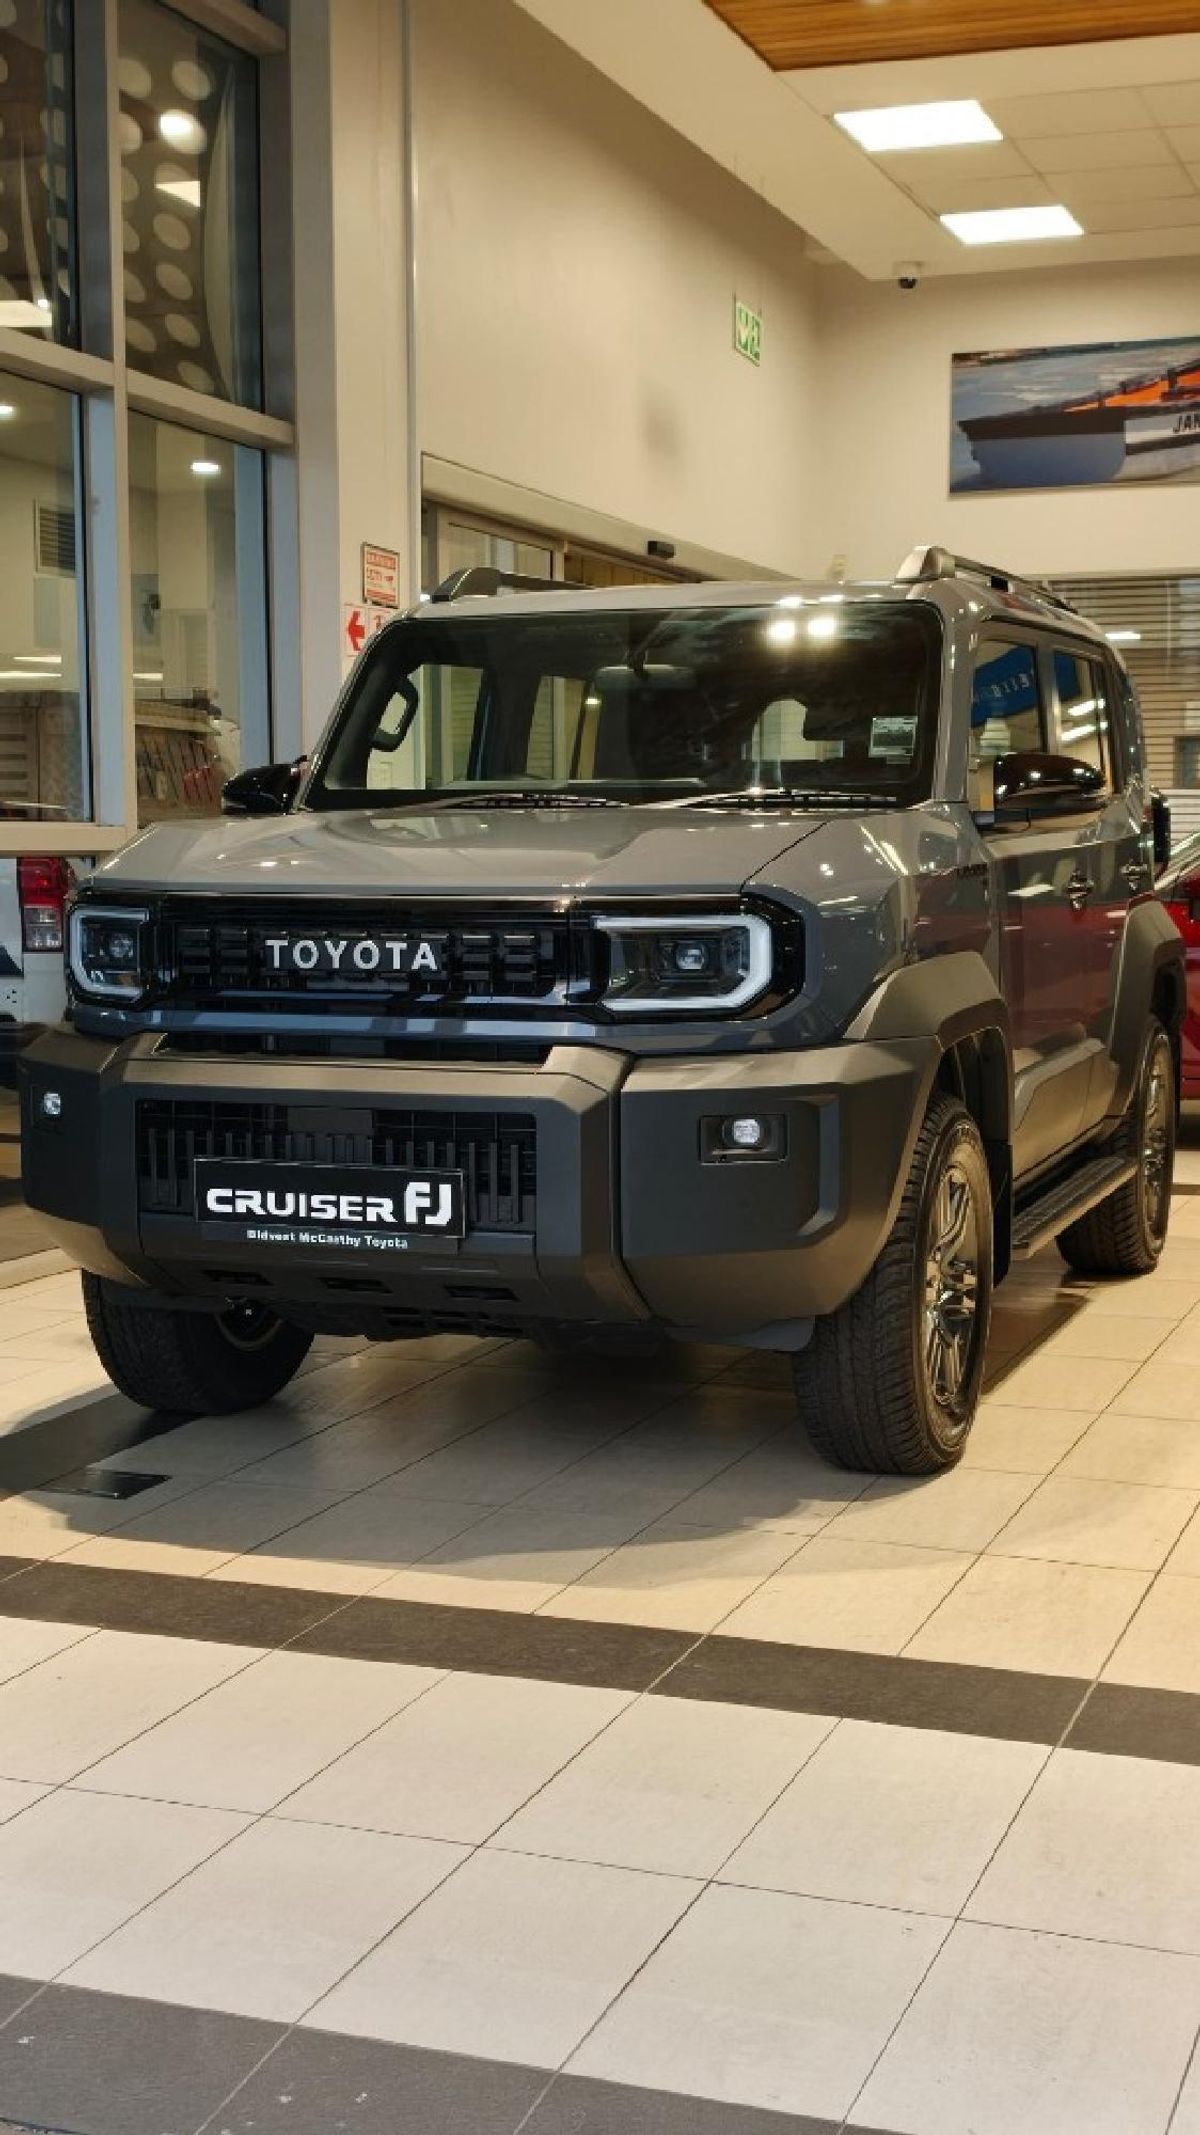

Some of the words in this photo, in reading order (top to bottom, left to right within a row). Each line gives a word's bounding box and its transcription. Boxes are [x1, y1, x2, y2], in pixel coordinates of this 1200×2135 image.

[265, 939, 438, 971] TOYOTA
[206, 1187, 398, 1223] CRUISER
[404, 1181, 452, 1226] FJ
[246, 1229, 296, 1243] Bidvest
[299, 1231, 361, 1247] McCarthy
[364, 1234, 408, 1249] Toyota
